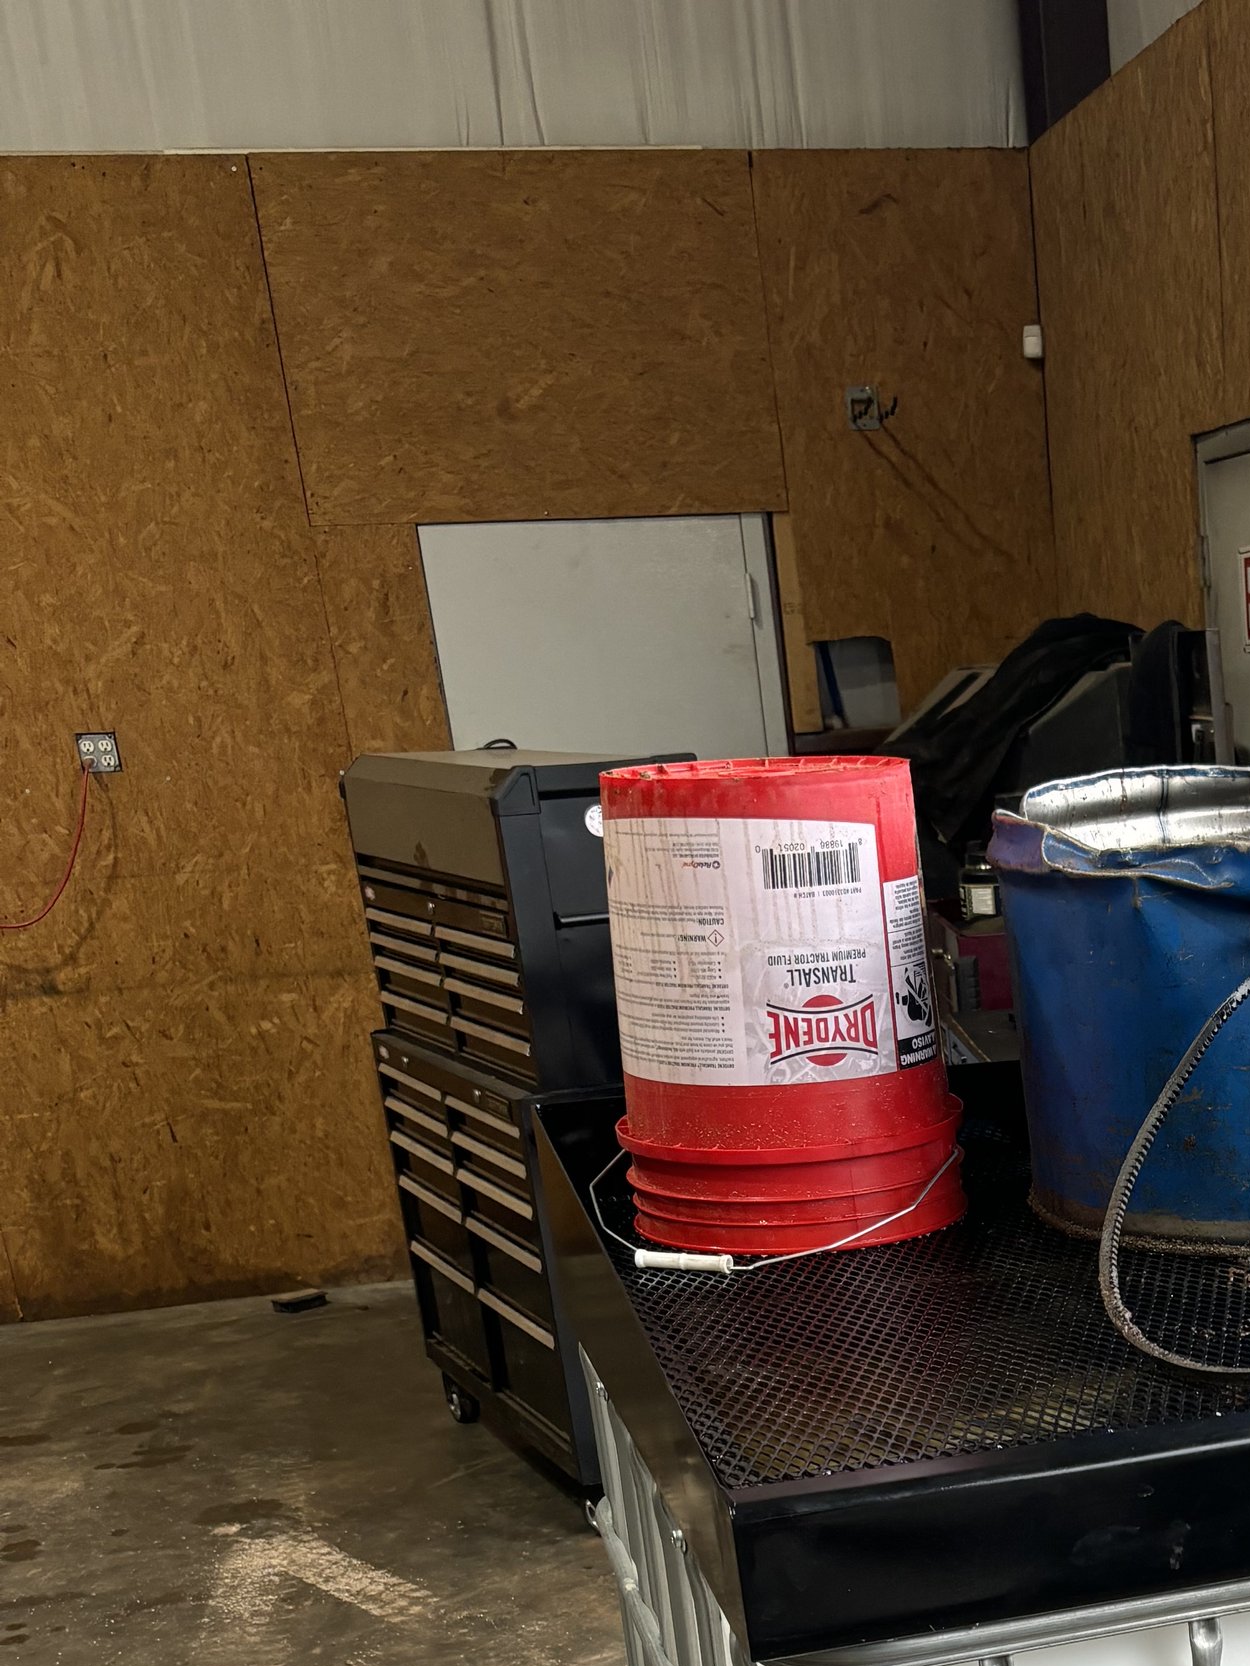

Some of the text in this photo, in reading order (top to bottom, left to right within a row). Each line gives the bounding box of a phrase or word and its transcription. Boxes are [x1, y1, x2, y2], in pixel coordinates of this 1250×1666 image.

[778, 842, 806, 852] 02051
[767, 948, 866, 967] PREMIUM TRACTOR FLUID
[766, 1001, 878, 1058] DRYDENE
[900, 1047, 933, 1066] WARNING
